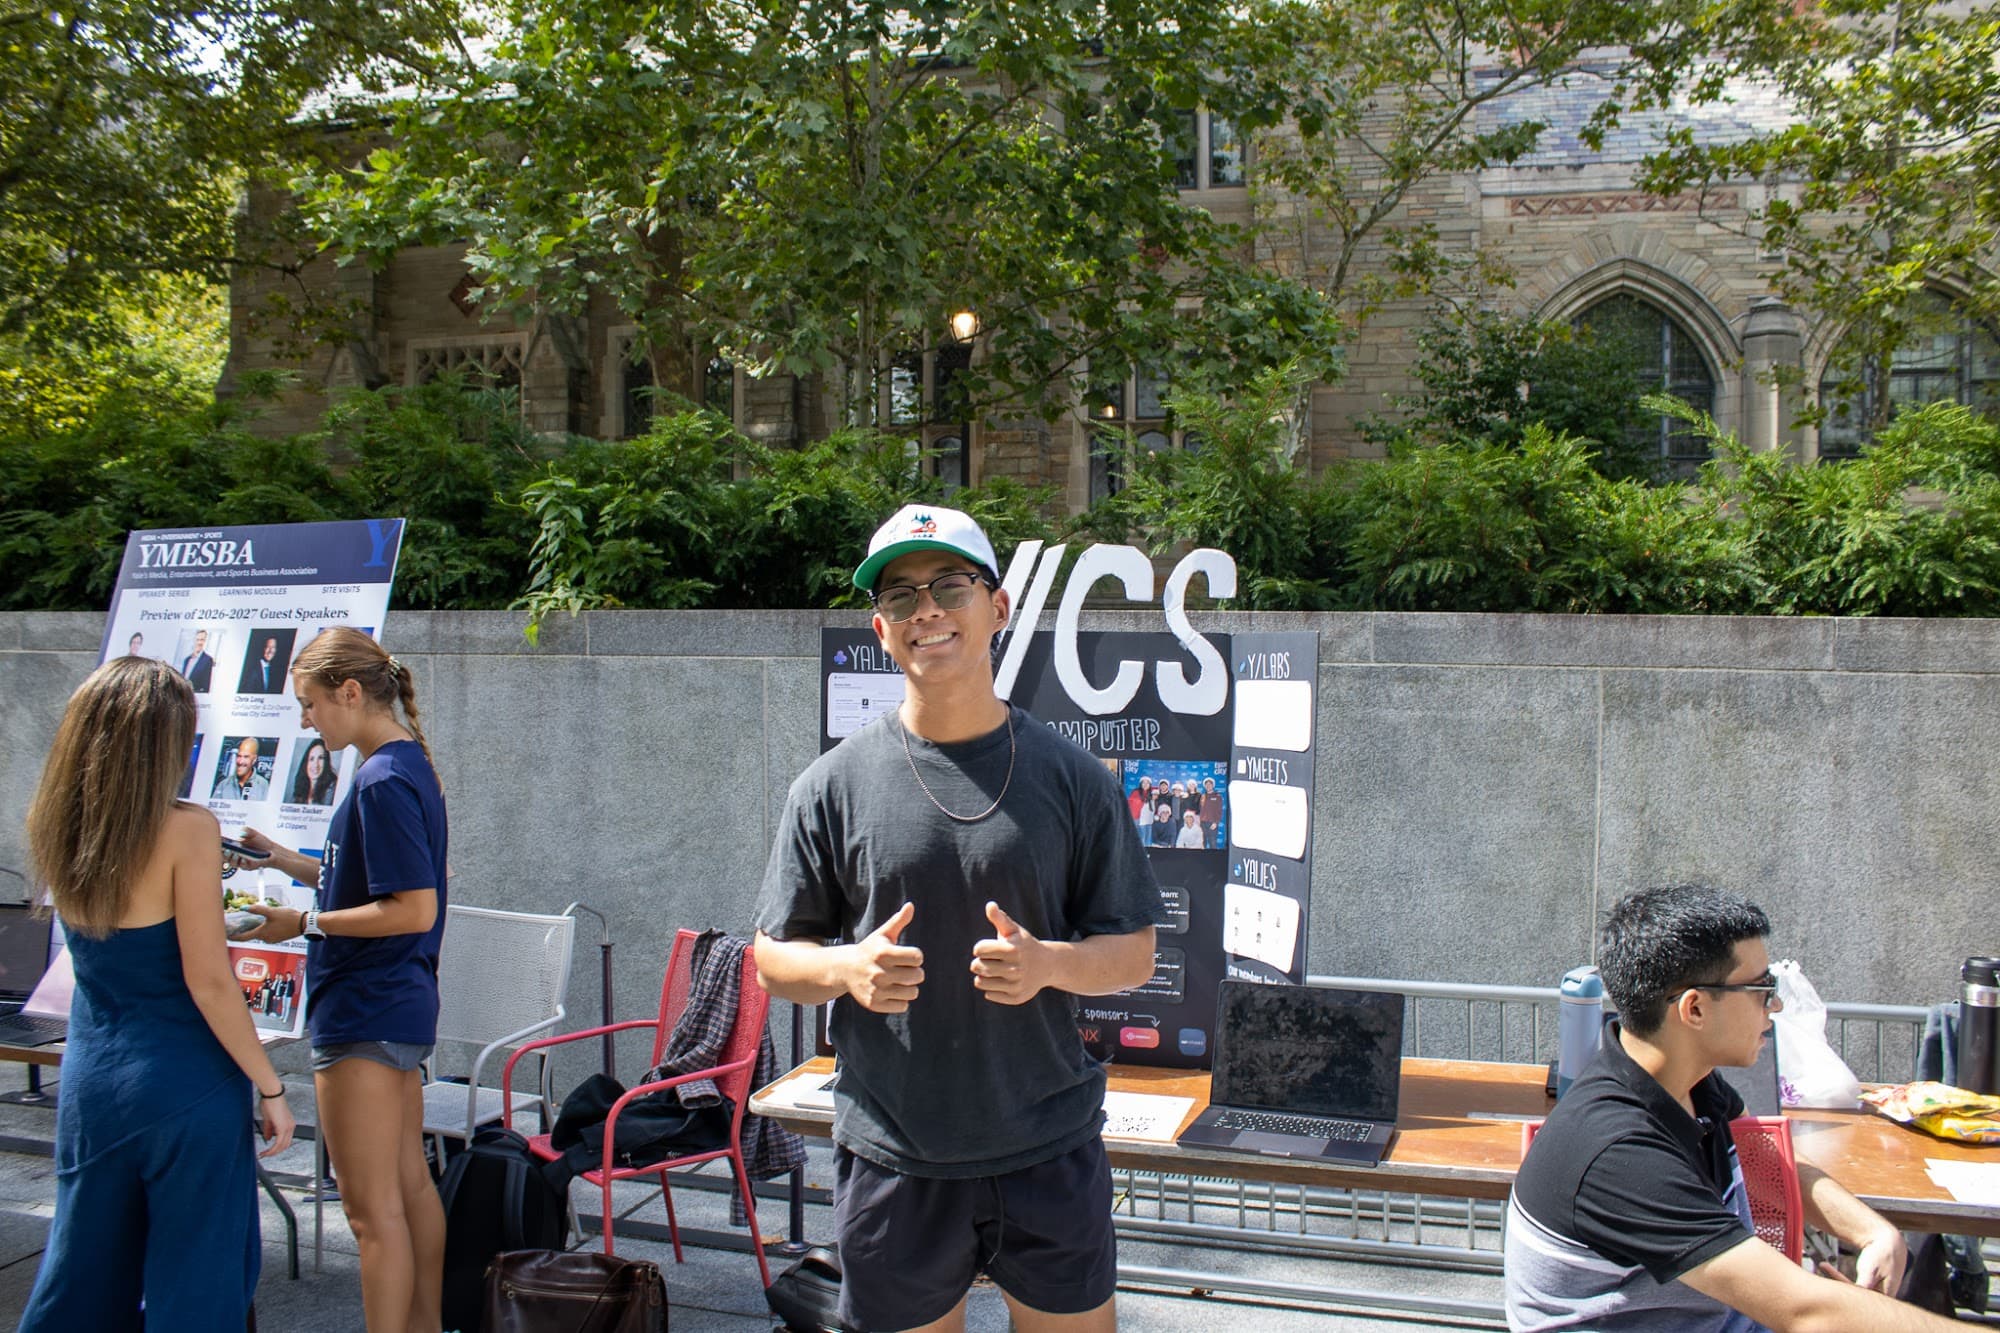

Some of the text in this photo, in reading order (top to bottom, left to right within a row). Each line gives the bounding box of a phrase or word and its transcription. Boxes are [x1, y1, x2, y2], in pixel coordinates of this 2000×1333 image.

[138, 540, 255, 568] YMESBA
[363, 520, 402, 567] Y
[230, 568, 250, 578] Sports
[251, 567, 279, 576] Business
[280, 566, 318, 576] Association
[219, 587, 287, 596] LEARNING MODULES
[322, 585, 361, 594] SITE VISITS
[140, 606, 349, 622] Preview of 2026-2027 Guest Speakers
[1247, 651, 1290, 680] Y/LABS
[1046, 718, 1161, 751] MPUTER
[1246, 755, 1288, 785] YMEETS
[1243, 857, 1277, 891] YALIES
[1084, 1008, 1129, 1021] sponsors
